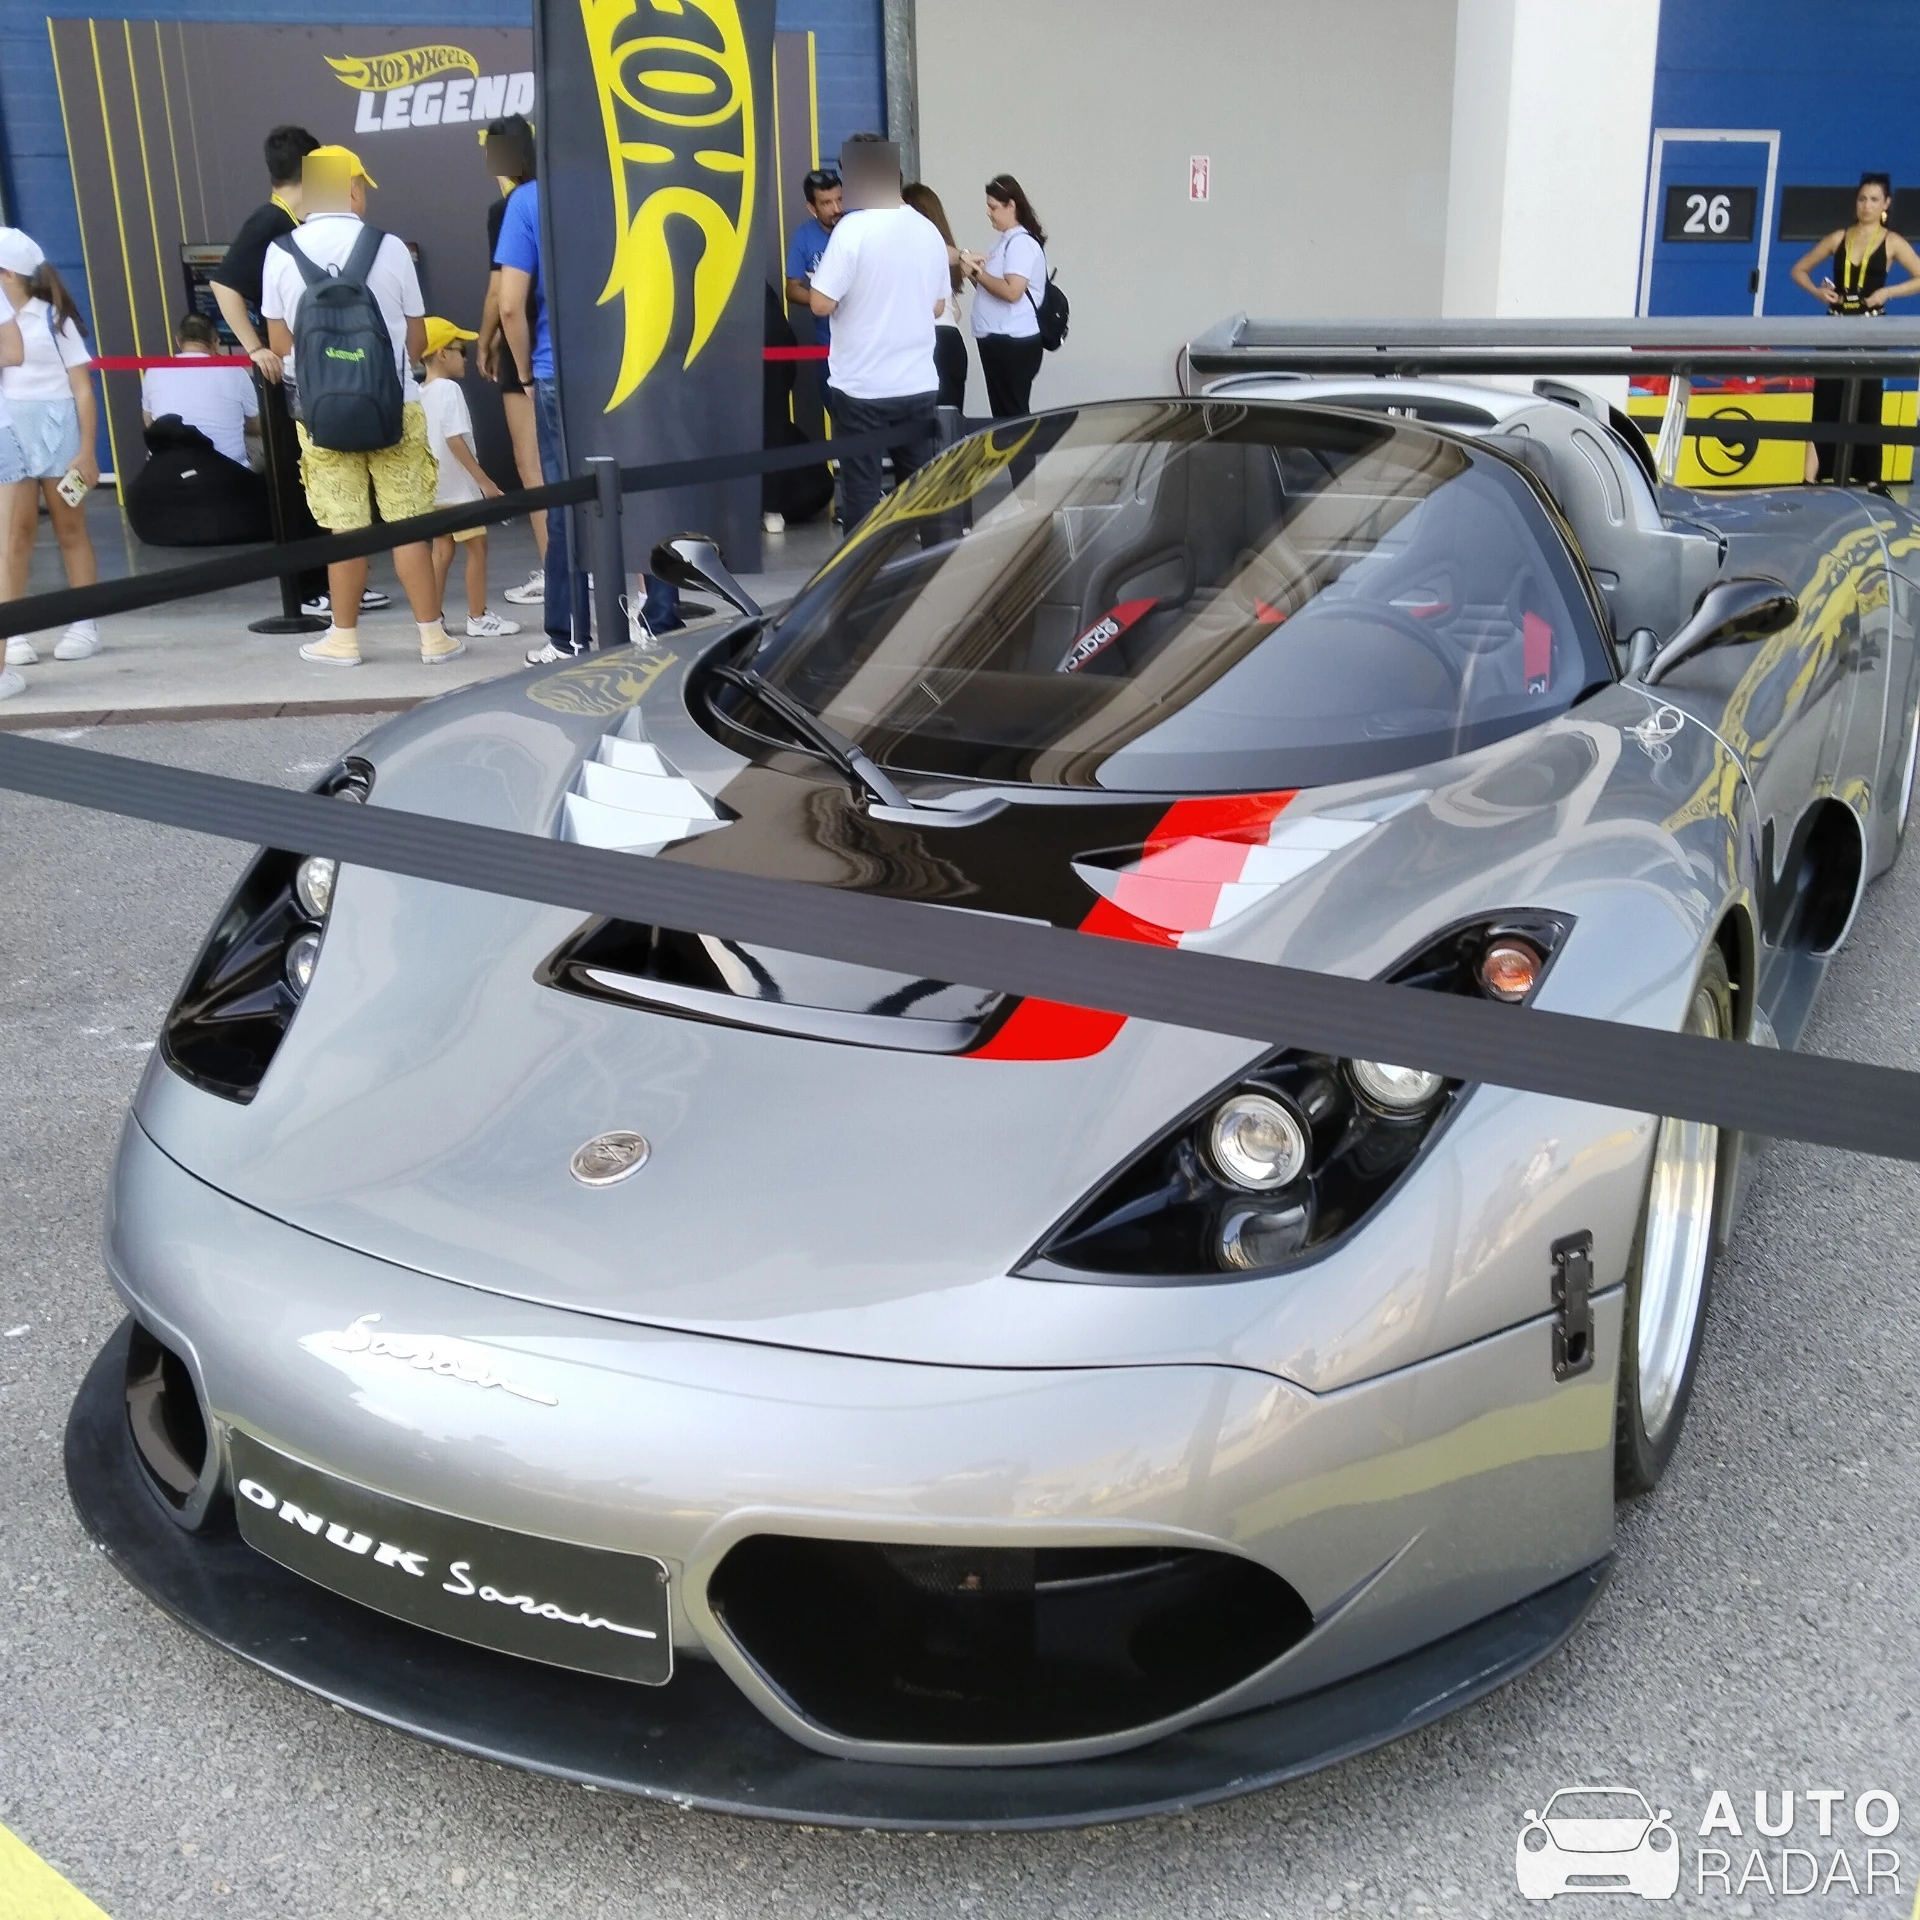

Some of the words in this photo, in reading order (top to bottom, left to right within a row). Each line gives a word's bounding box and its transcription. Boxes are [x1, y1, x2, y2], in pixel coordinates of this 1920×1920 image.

[366, 59, 403, 88] HOT
[1683, 194, 1731, 234] 26
[238, 1478, 429, 1577] ONUK
